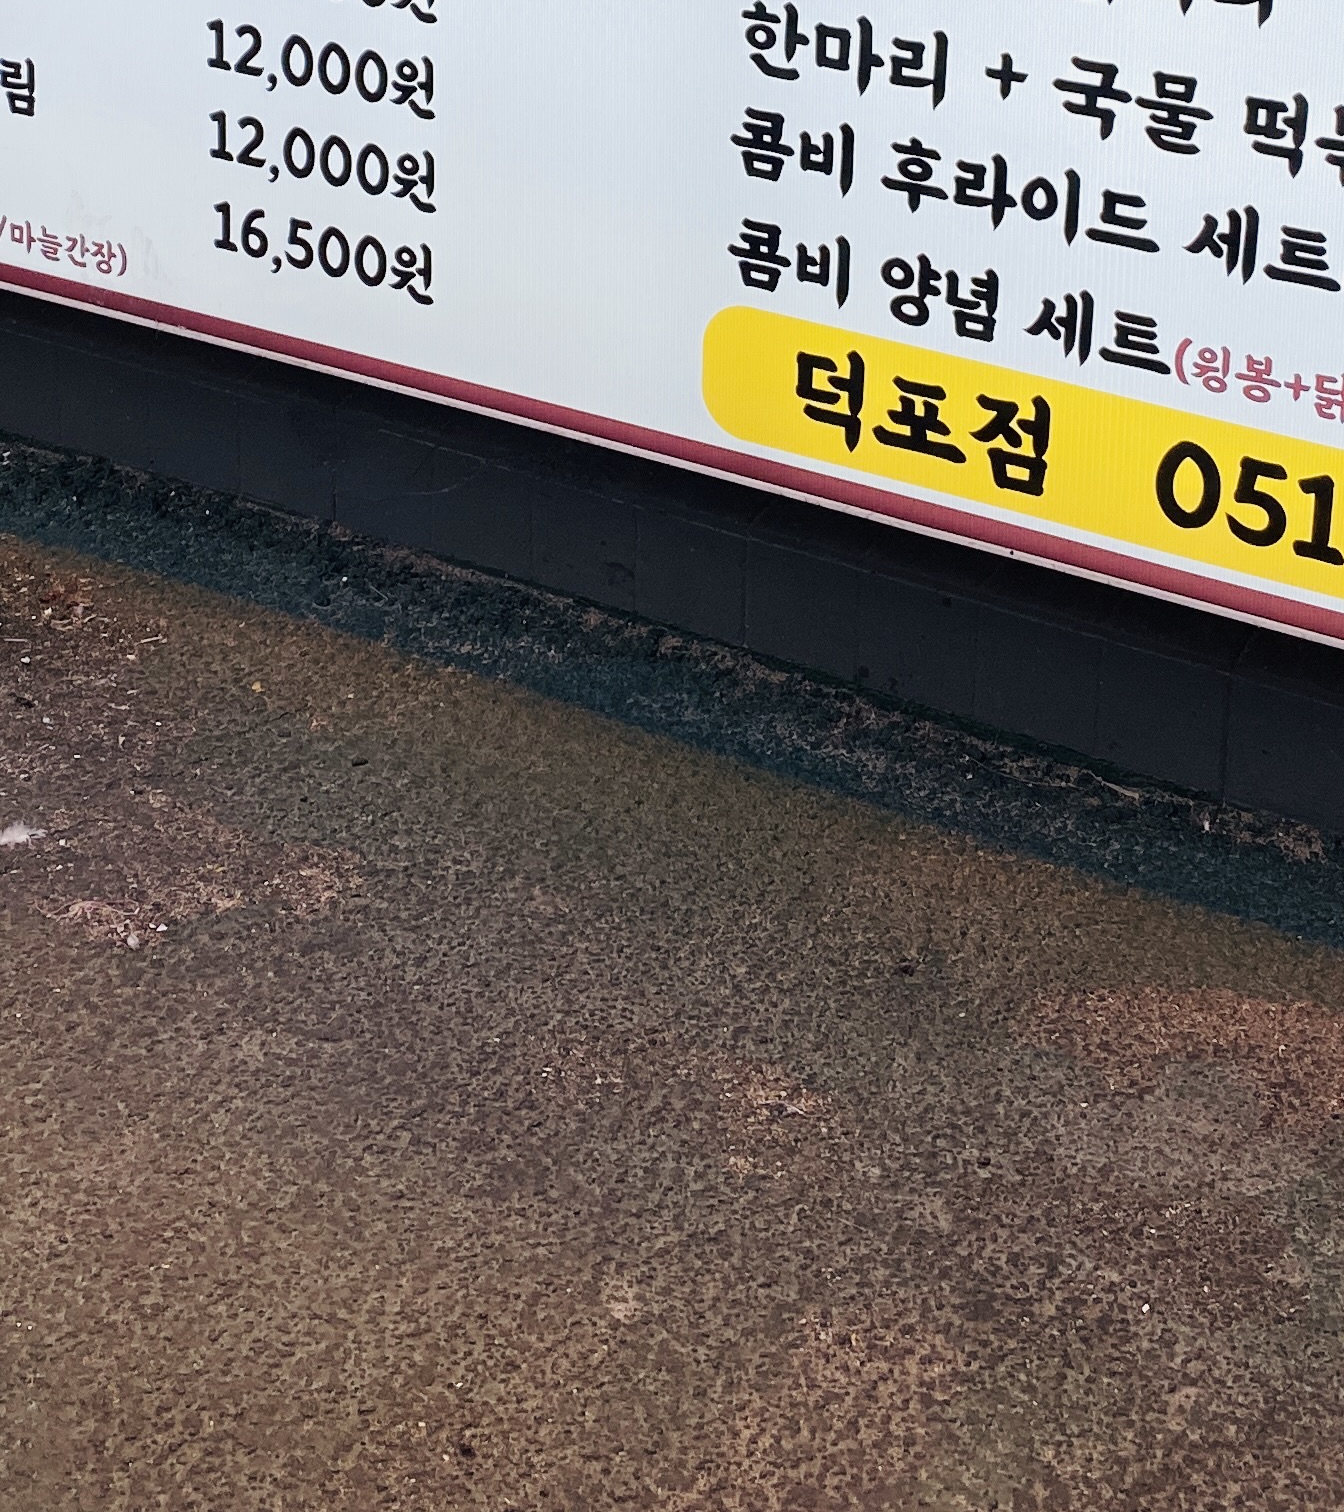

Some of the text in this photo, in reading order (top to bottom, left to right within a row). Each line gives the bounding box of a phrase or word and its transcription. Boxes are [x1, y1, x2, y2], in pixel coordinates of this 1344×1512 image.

[206, 17, 436, 119] 12,000원
[741, 0, 950, 111] 한마리
[985, 52, 1030, 100] +
[1053, 56, 1213, 156] 국물
[208, 109, 437, 214] 12,000원
[730, 107, 855, 198] 콤비
[879, 137, 1161, 255] 후라이드
[213, 200, 434, 306] 16,500원
[728, 217, 852, 308] 콤비
[878, 254, 996, 343] 양념
[793, 348, 1054, 499] 덕포점
